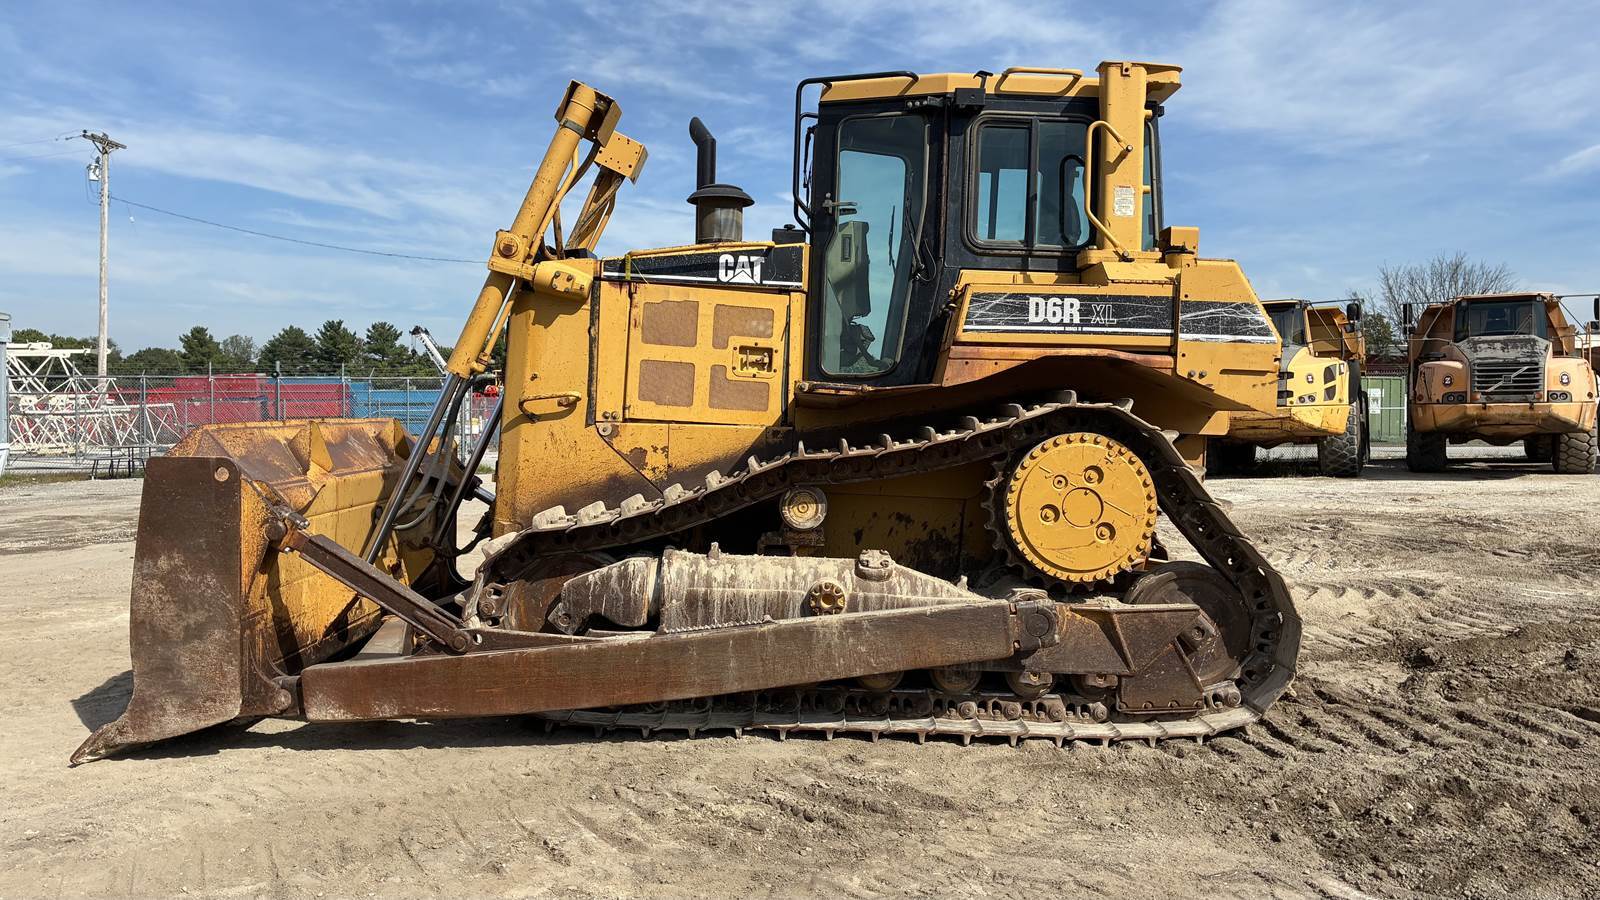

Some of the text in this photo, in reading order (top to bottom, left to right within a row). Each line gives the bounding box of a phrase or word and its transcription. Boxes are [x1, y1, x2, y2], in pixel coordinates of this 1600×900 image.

[718, 253, 765, 284] CAT
[1028, 297, 1117, 325] D6R XL
